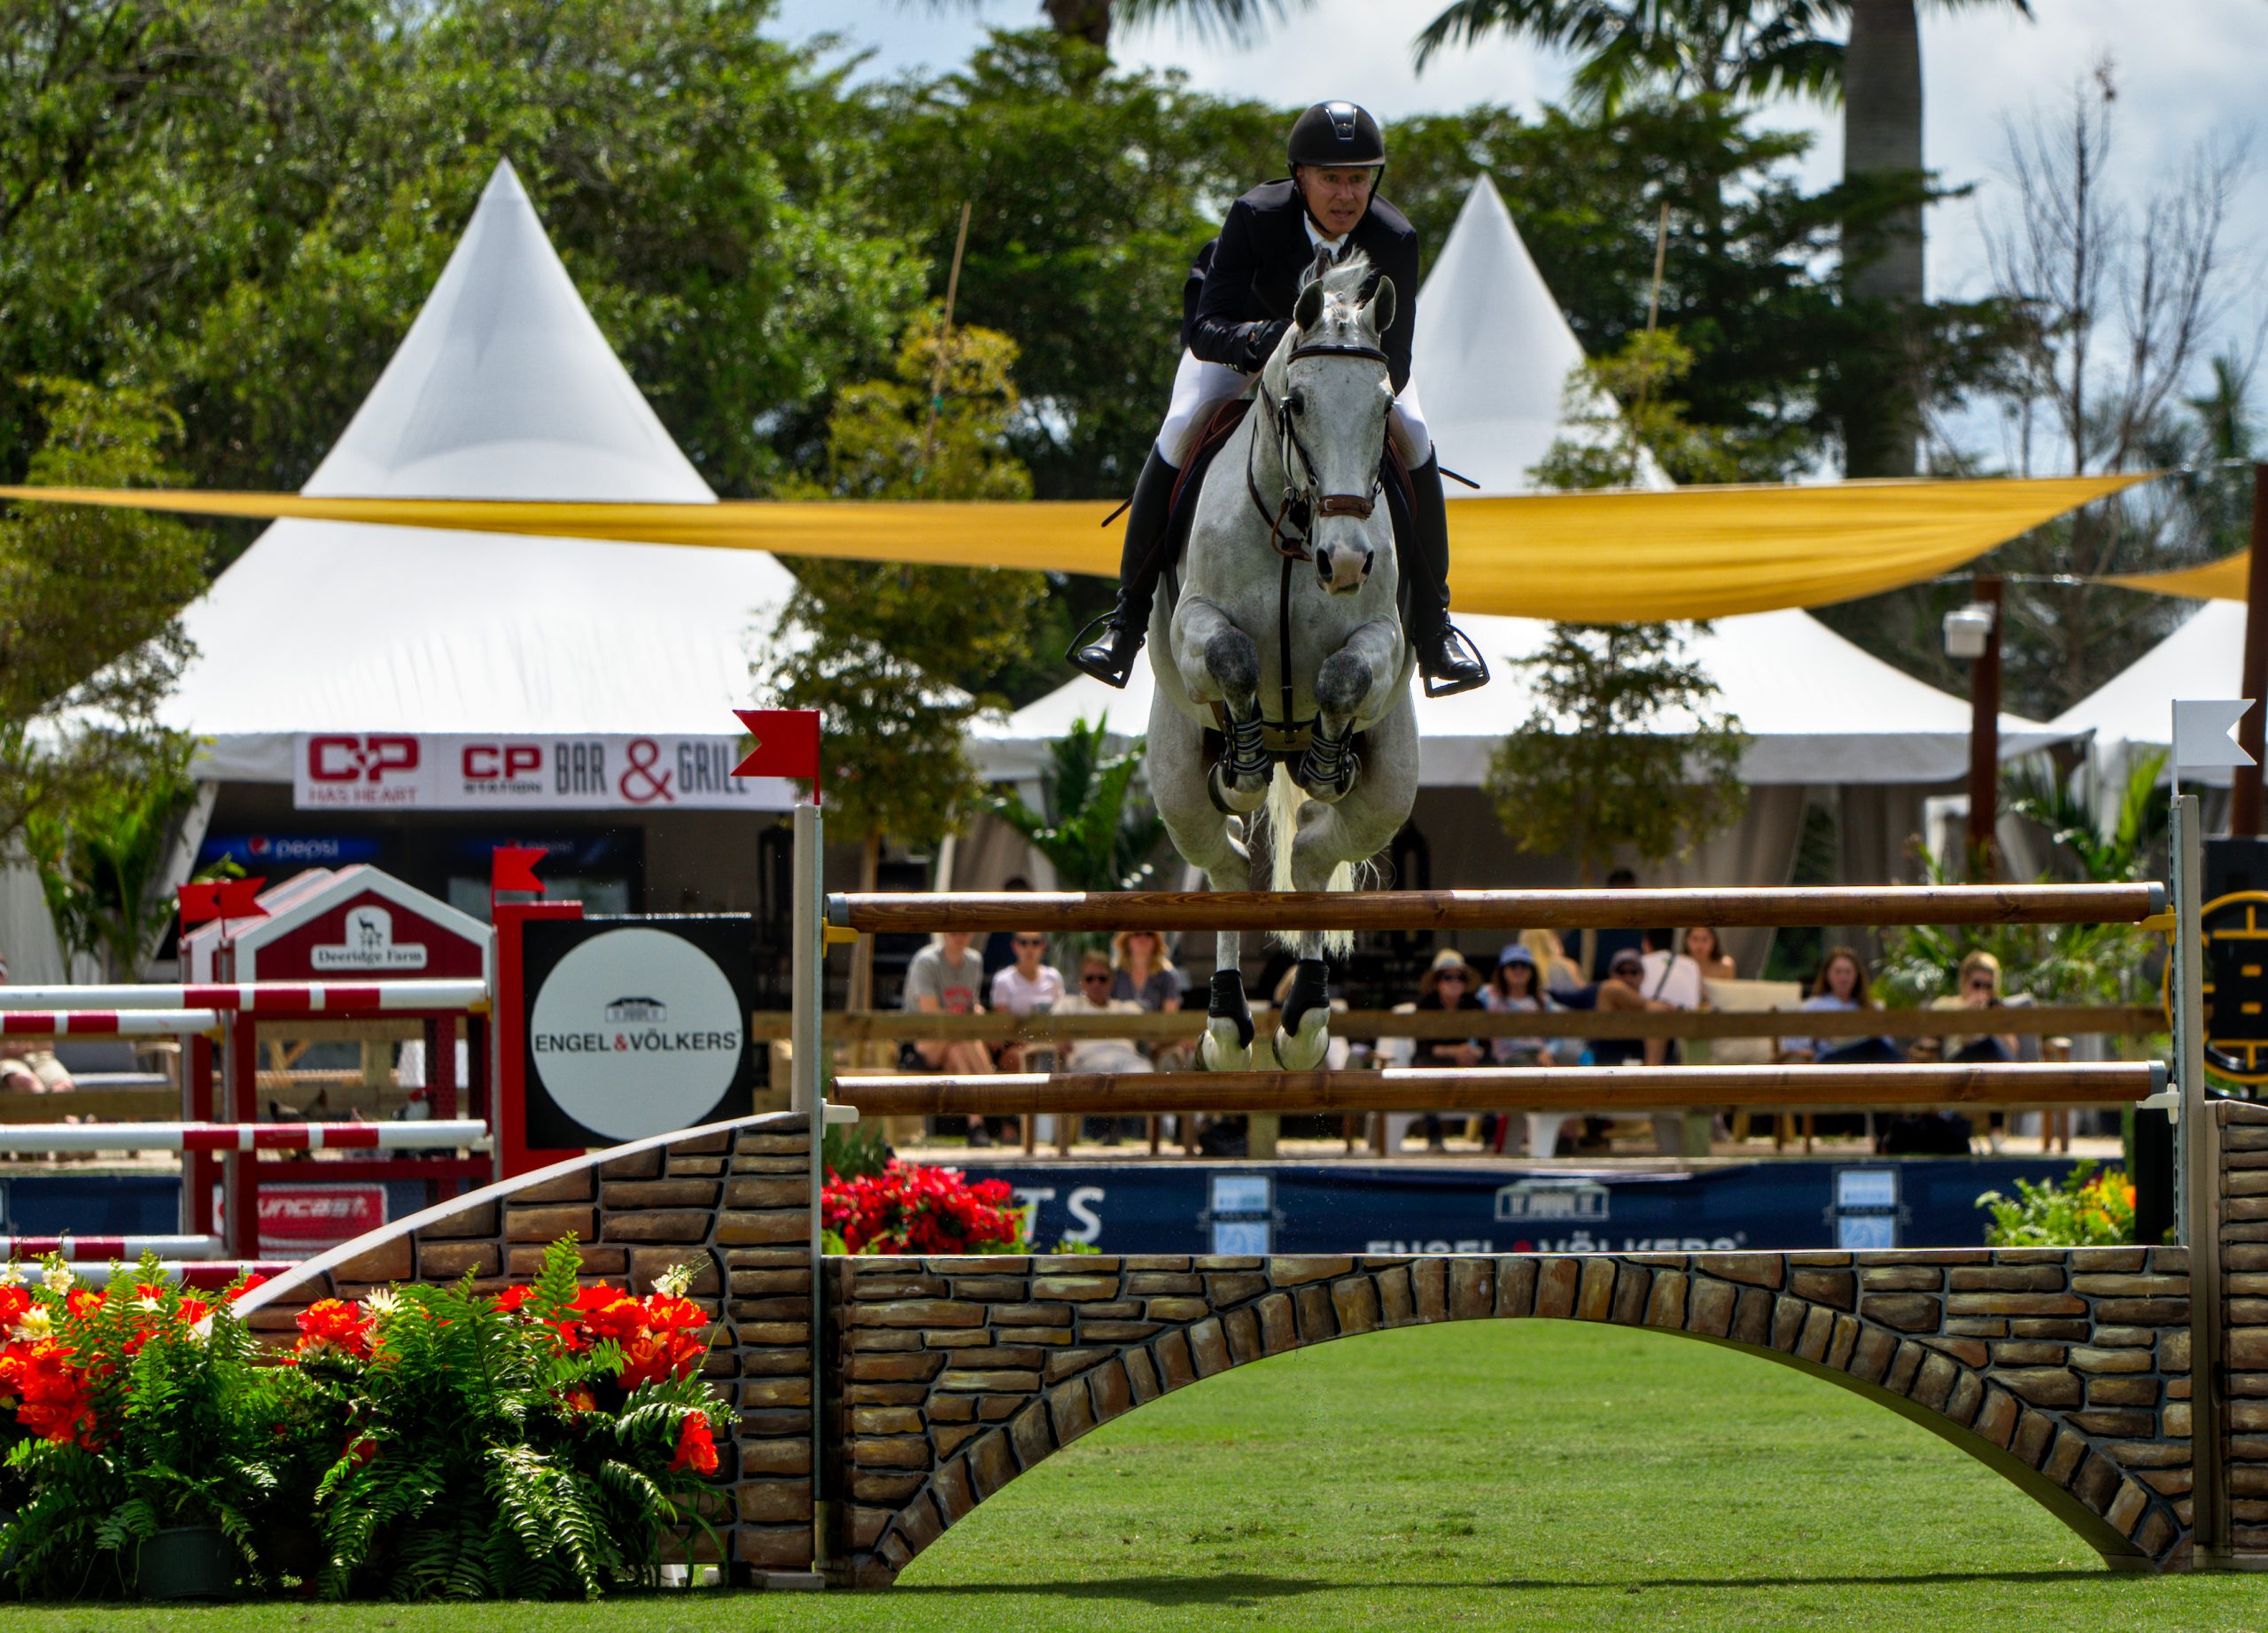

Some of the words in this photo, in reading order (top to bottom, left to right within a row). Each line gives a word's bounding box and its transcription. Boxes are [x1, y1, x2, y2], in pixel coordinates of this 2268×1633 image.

[462, 745, 542, 780] CP
[555, 742, 606, 795] BAR
[619, 736, 675, 804] &
[309, 788, 347, 804] HAS
[353, 787, 417, 803] HEART
[387, 950, 423, 962] Farm
[257, 1196, 364, 1218] uncast
